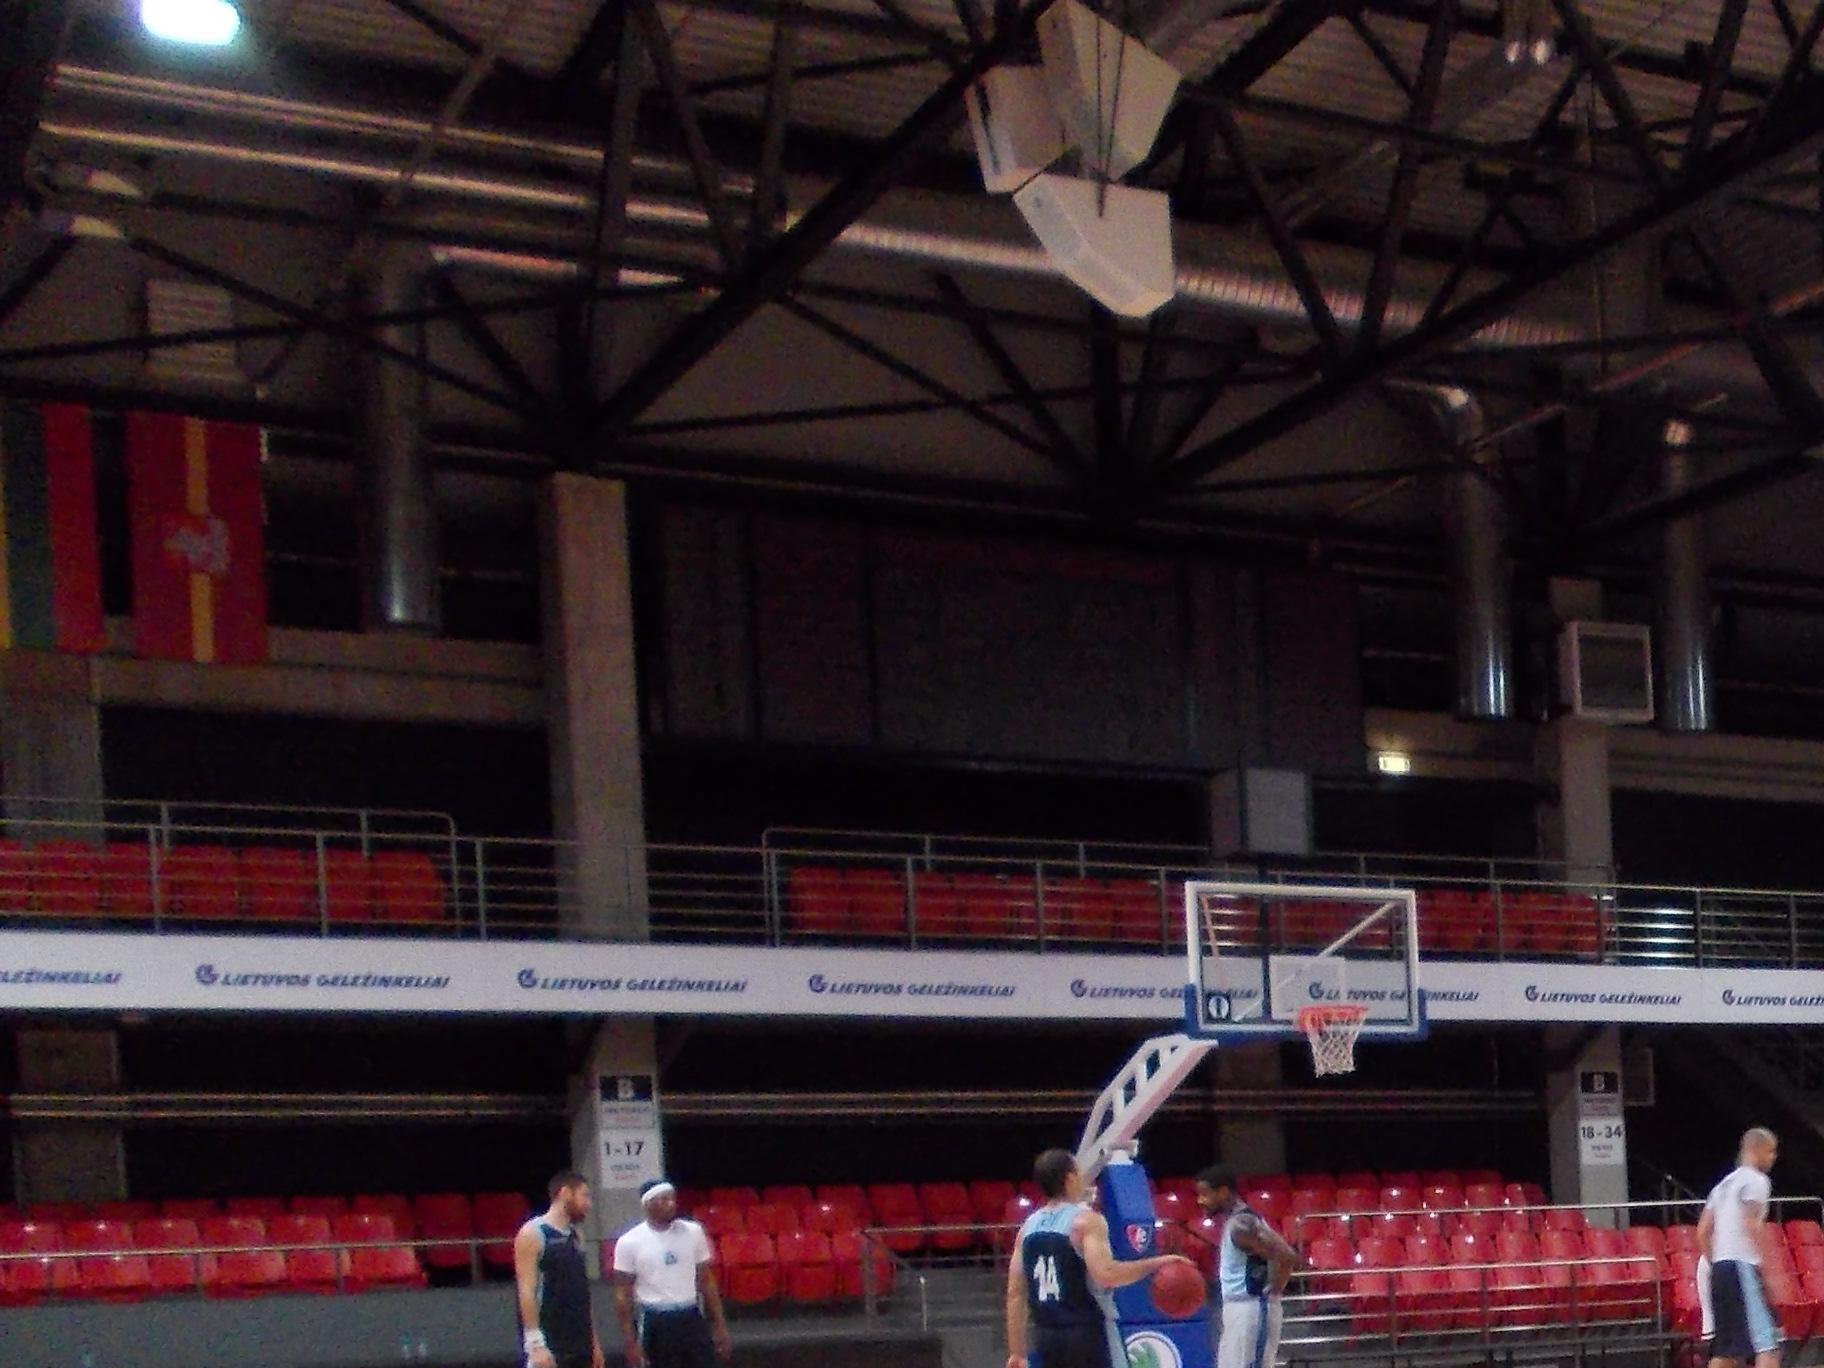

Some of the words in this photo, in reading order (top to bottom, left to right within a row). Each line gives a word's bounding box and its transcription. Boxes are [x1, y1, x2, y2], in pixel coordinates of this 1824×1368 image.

[540, 977, 623, 991] LIETUVOS
[829, 981, 903, 995] LIETUVOS
[1033, 1255, 1060, 1301] 14
